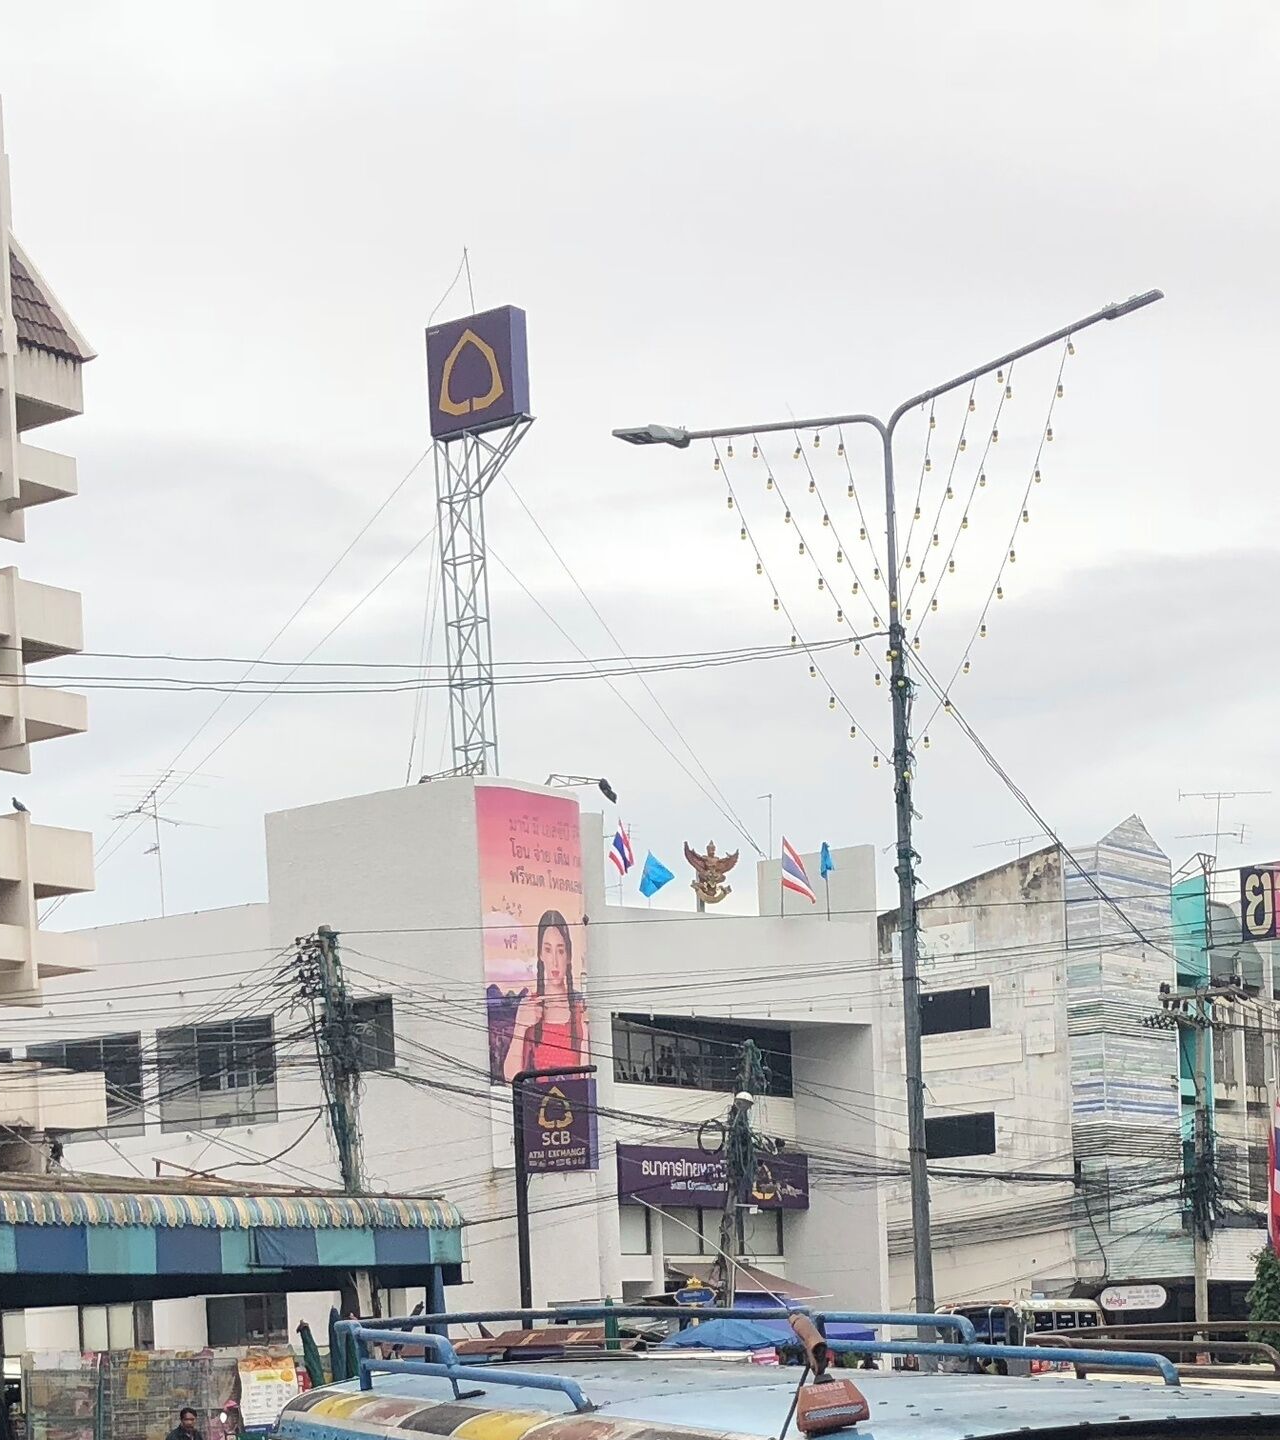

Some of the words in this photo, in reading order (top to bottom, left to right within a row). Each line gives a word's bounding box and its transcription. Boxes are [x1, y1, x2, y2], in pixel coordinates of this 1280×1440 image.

[541, 1131, 571, 1146] SCB
[528, 1151, 545, 1159] ATM
[547, 1147, 587, 1158] EXCHANGE
